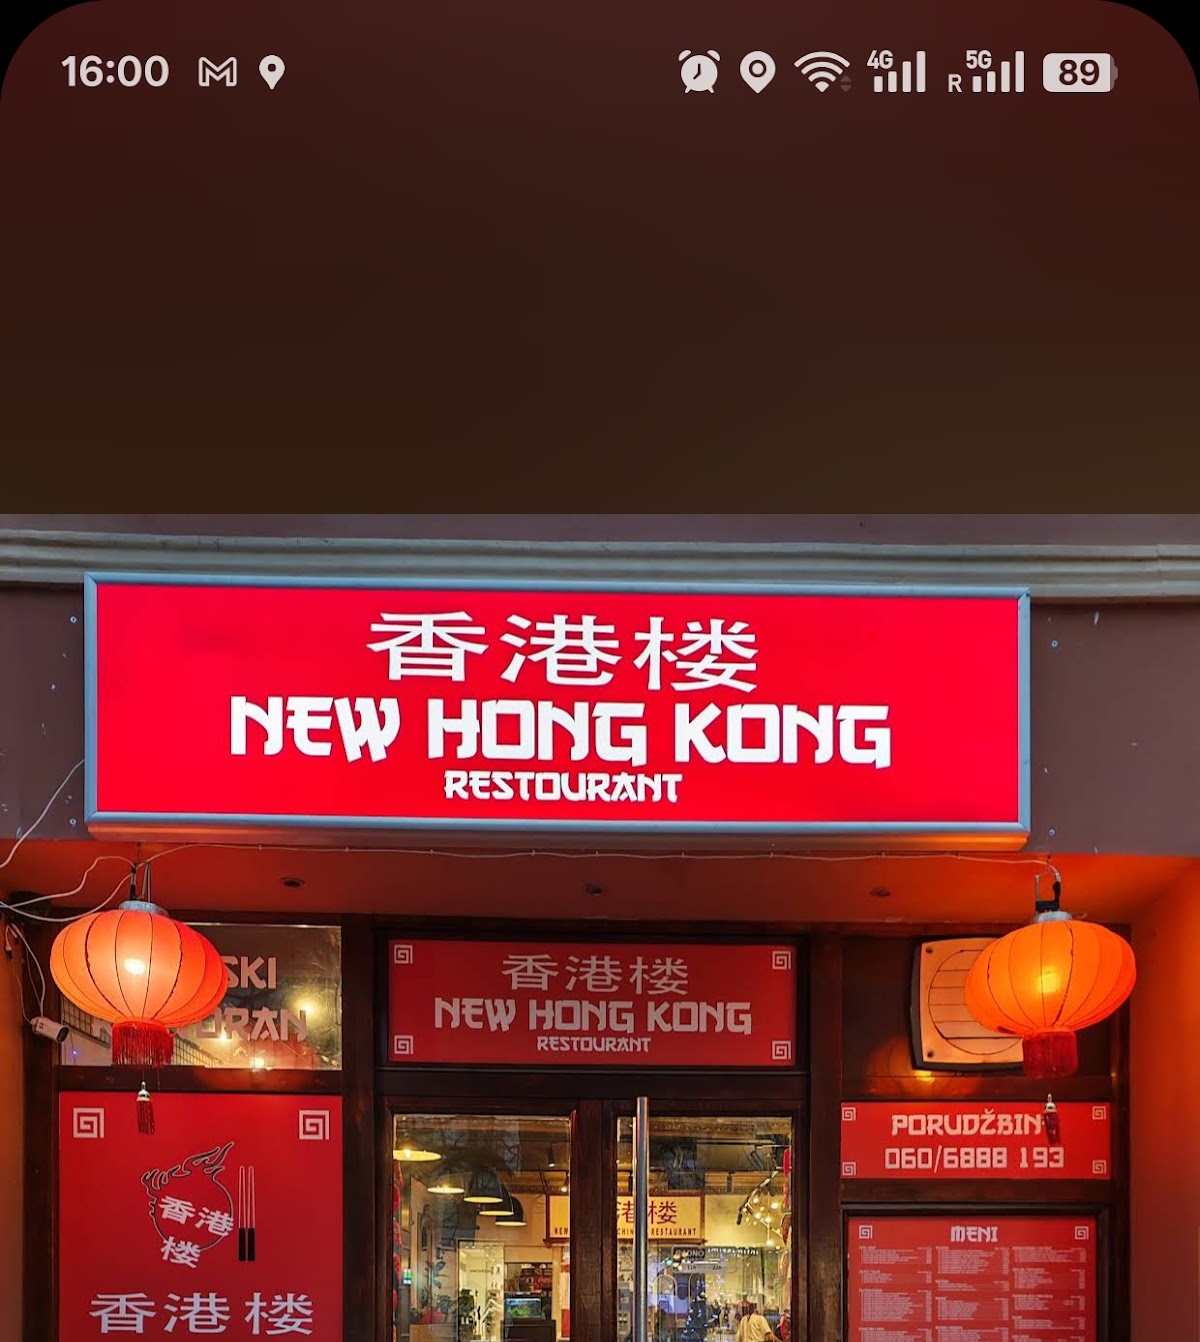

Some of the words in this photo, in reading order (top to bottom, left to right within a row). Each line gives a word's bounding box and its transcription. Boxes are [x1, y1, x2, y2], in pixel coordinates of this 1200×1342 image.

[366, 611, 759, 693] 香港楼
[230, 696, 400, 763] NEW
[427, 698, 649, 767] HONG
[674, 702, 892, 769] KONG
[444, 770, 684, 803] RESTOURANT
[501, 953, 689, 996] 香港楼
[434, 997, 517, 1032] NEW
[529, 999, 633, 1034] HONG
[647, 1001, 752, 1036] KONG
[537, 1036, 651, 1053] RESTOURANT
[891, 1109, 1046, 1136] PORUDŽBIN
[885, 1145, 1008, 1173] 060/6888
[1019, 1147, 1065, 1168] 193
[651, 1228, 697, 1236] RESTAURANT
[950, 1226, 998, 1243] MENI
[89, 1292, 314, 1335] 香港楼
